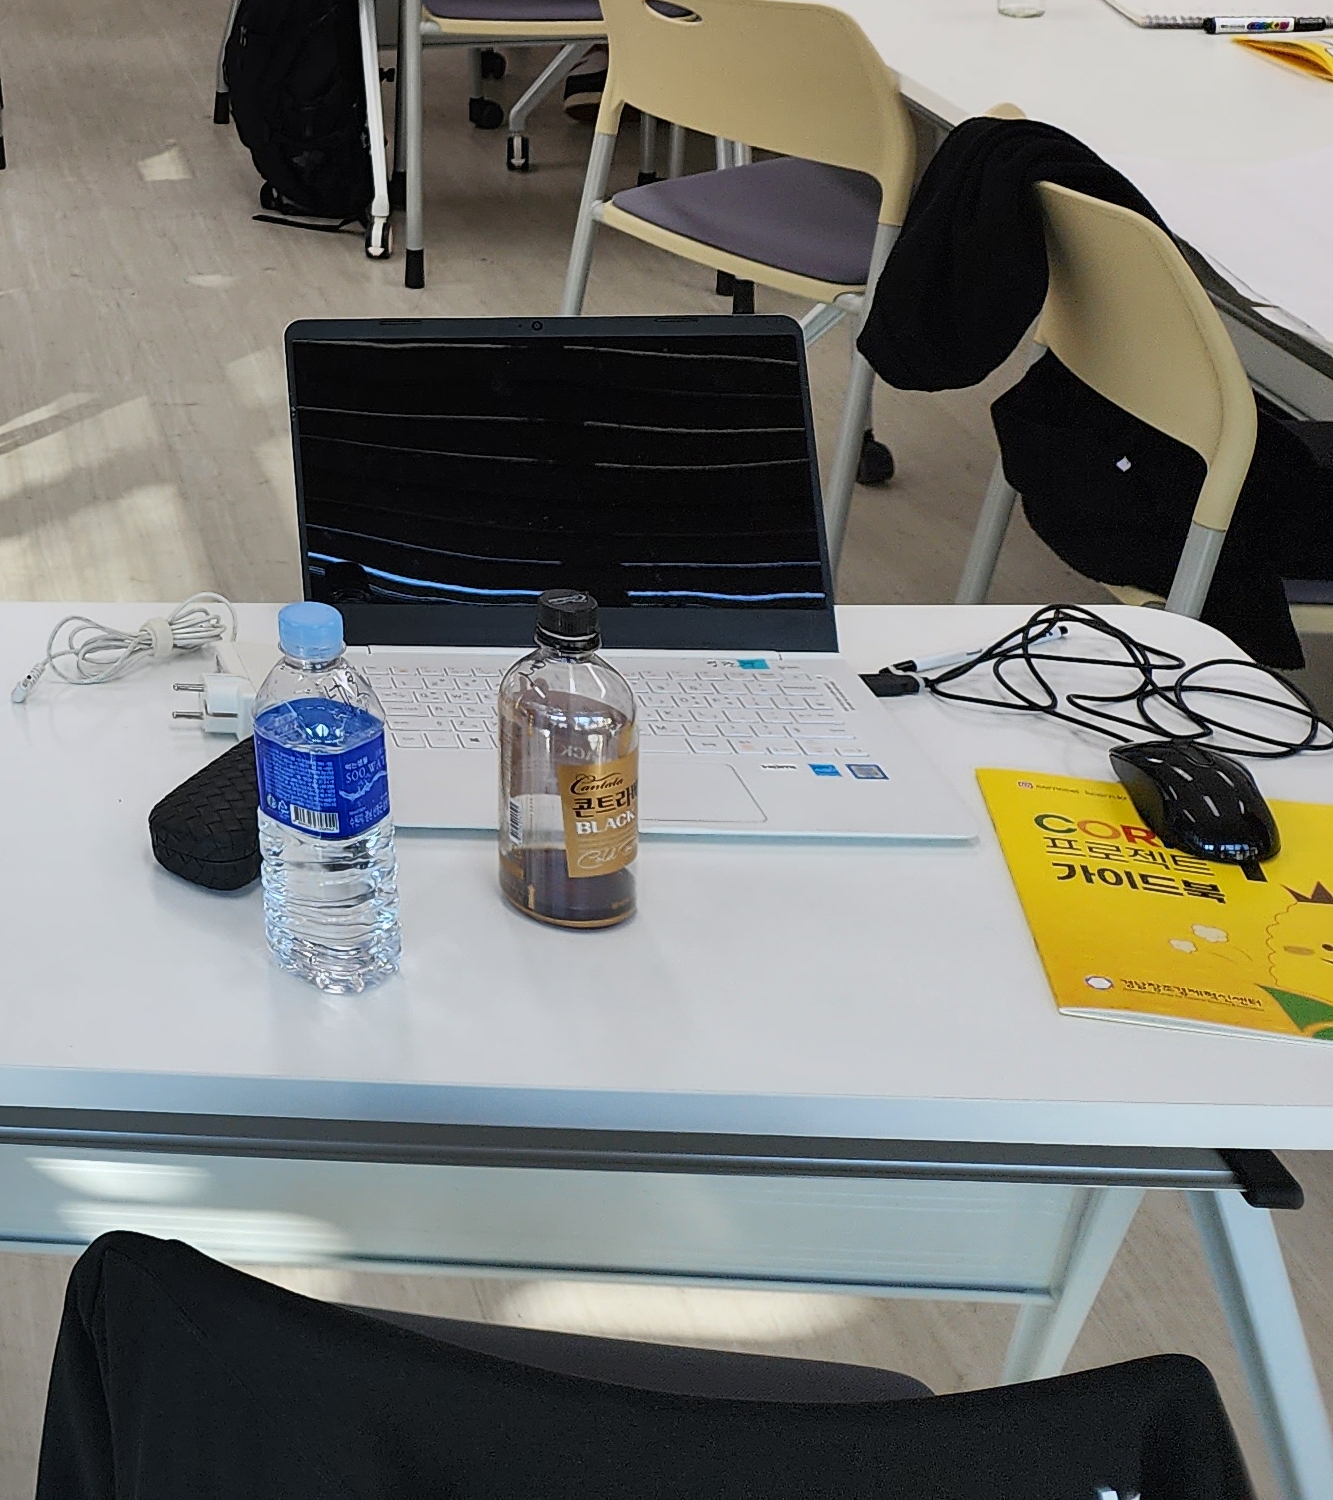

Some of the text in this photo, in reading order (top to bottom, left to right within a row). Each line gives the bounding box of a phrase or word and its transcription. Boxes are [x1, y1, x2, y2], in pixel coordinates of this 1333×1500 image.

[572, 780, 638, 819] 콘트라
[576, 809, 636, 836] BLACK
[1033, 813, 1164, 848] COR
[1042, 835, 1216, 877] 프로젝트
[1051, 861, 1227, 905] 가이드북
